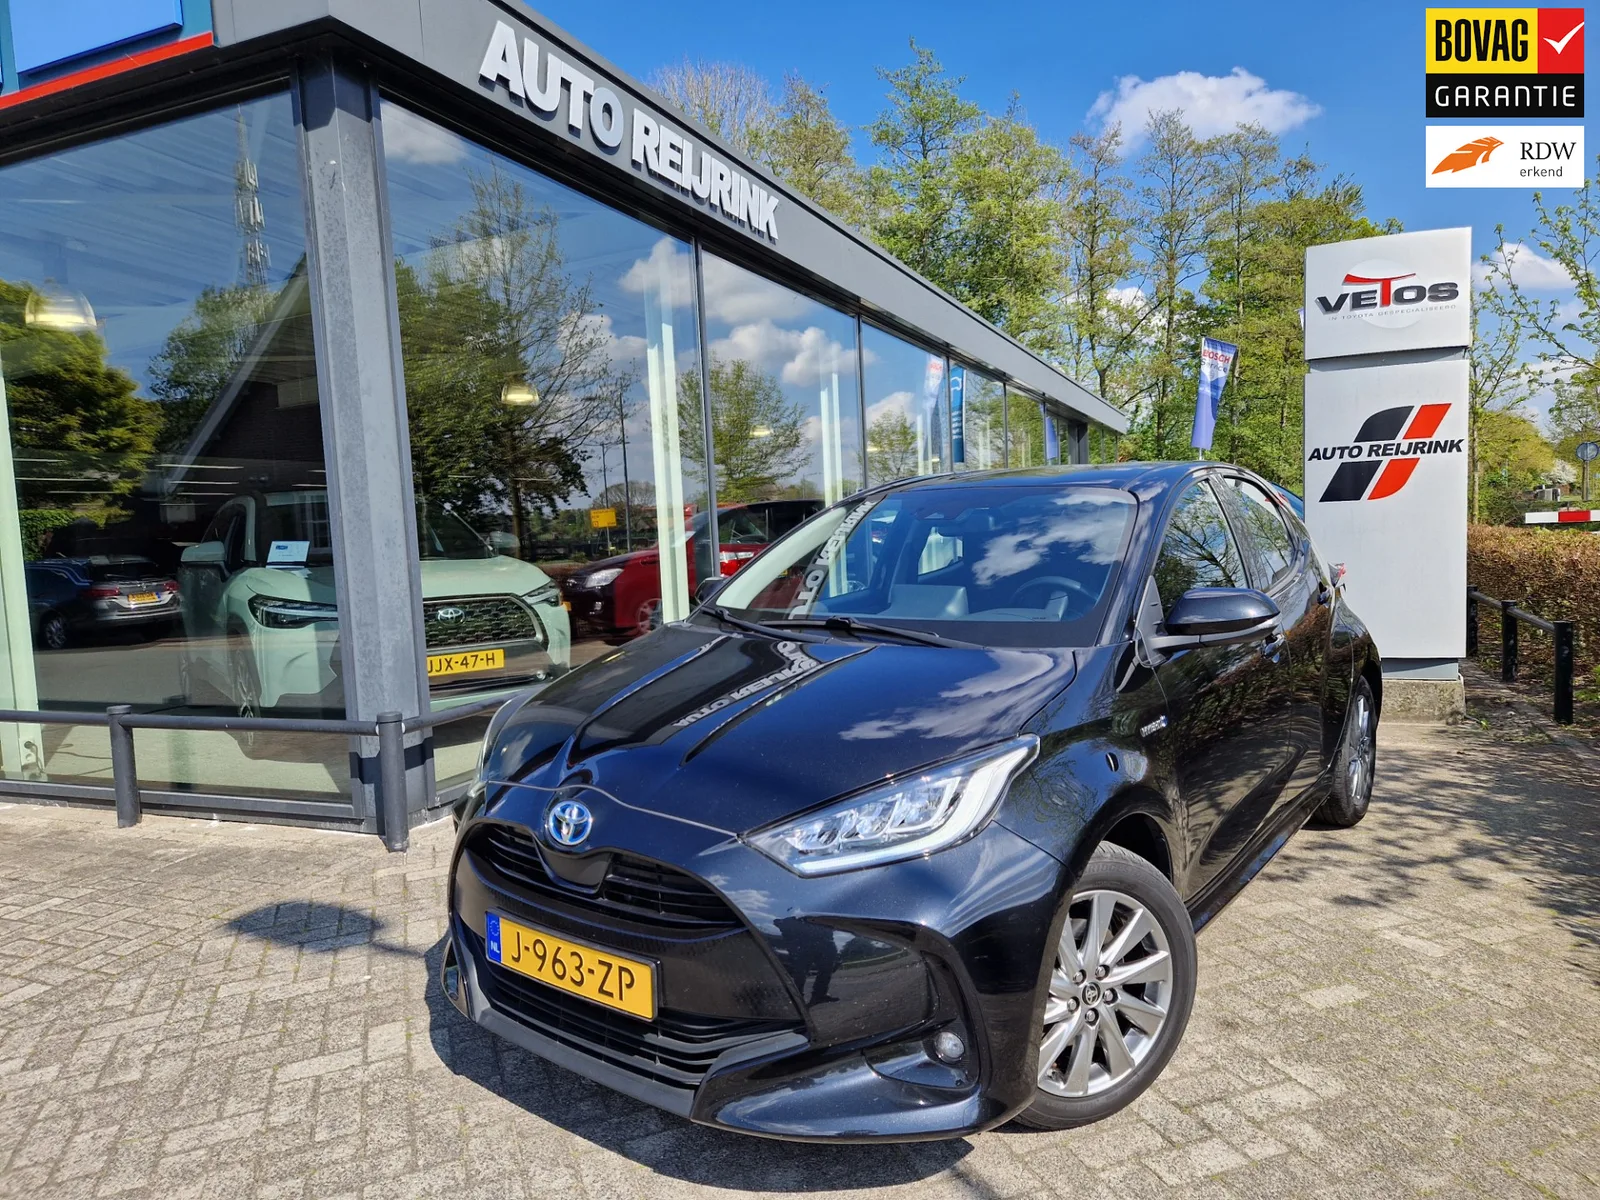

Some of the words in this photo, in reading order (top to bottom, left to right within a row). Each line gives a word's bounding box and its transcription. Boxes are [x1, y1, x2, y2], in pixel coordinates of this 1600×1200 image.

[479, 20, 625, 149] AUTO
[631, 108, 780, 241] REIJRINK
[1316, 273, 1460, 314] VETOS
[1342, 312, 1374, 320] TOYOTA
[1202, 349, 1231, 364] BOSCH
[1307, 444, 1363, 462] AUTO
[1367, 438, 1465, 458] REIJRINK
[490, 940, 500, 954] NL
[511, 931, 636, 1002] J-963-ZP
